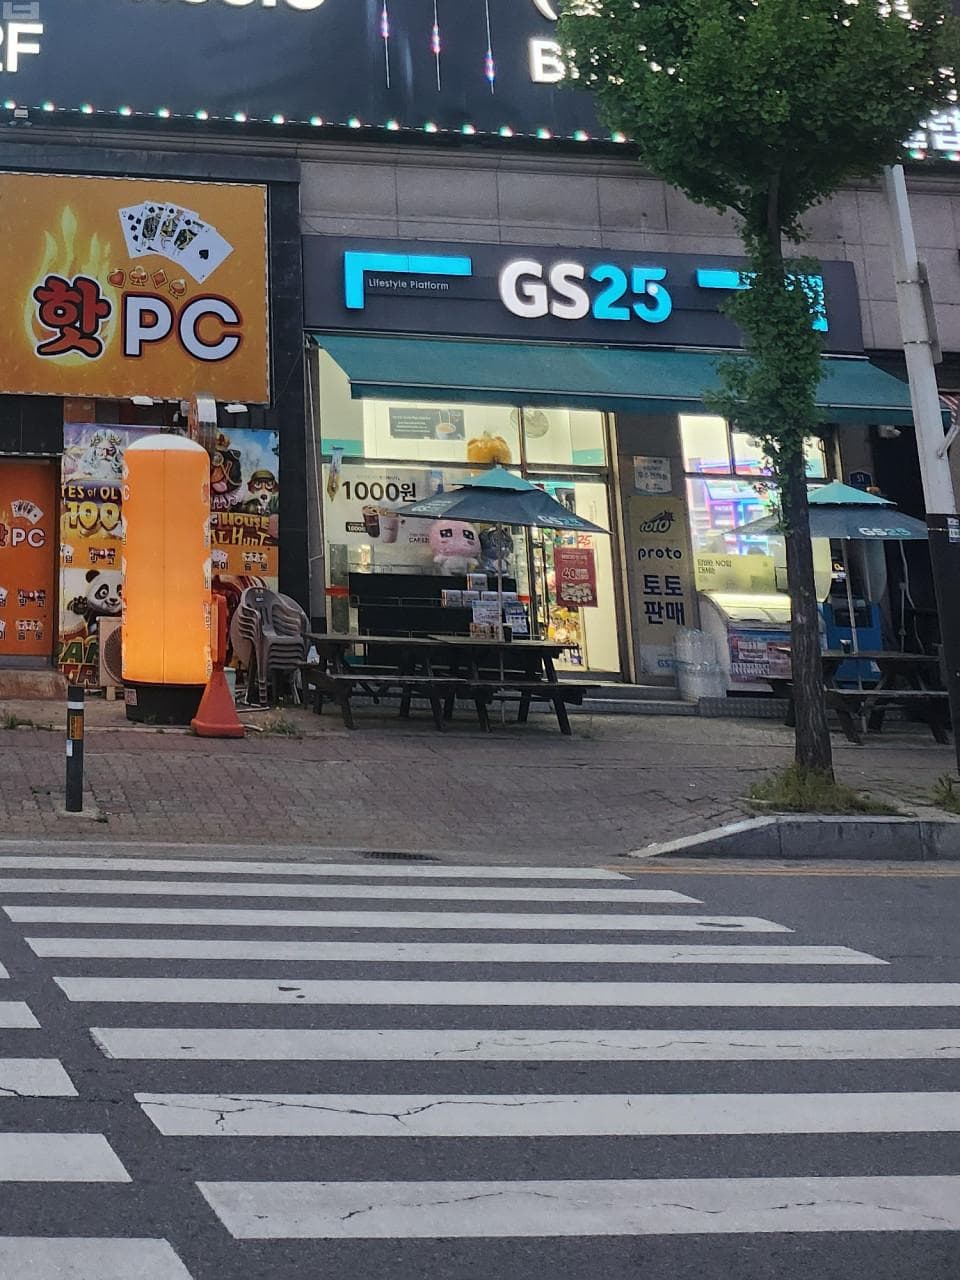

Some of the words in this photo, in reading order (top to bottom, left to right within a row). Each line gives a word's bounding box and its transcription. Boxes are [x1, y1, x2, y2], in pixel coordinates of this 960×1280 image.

[367, 277, 408, 290] Lifestyle
[410, 278, 450, 292] Platform
[499, 259, 674, 324] GS25
[342, 480, 417, 503] 1000원
[858, 526, 912, 537] GS25
[638, 547, 682, 560] proto
[643, 574, 684, 597] 토토
[644, 601, 686, 626] 판매
